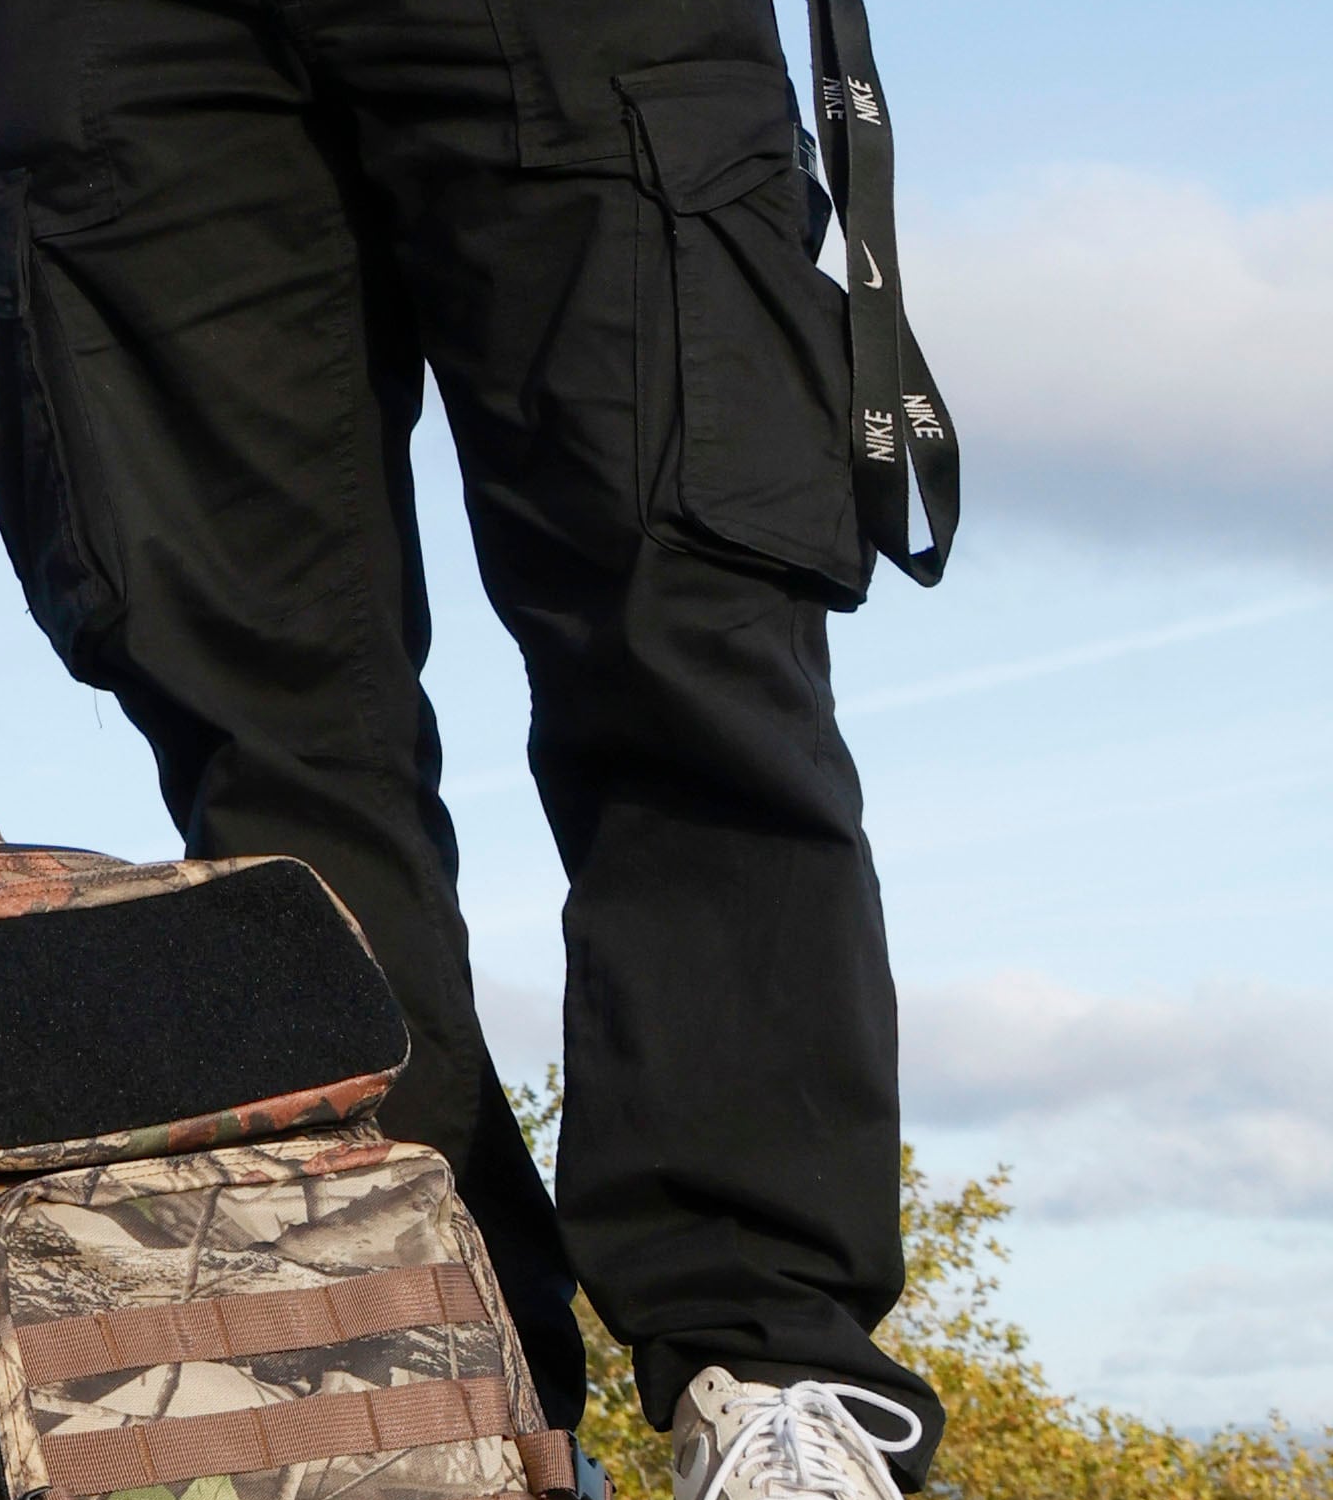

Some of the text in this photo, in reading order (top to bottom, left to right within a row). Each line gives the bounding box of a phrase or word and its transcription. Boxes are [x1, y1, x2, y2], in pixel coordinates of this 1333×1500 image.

[822, 76, 845, 121] NIKE
[847, 74, 882, 126] NIKE
[864, 408, 895, 462] NIKE
[901, 394, 944, 440] NIKE
